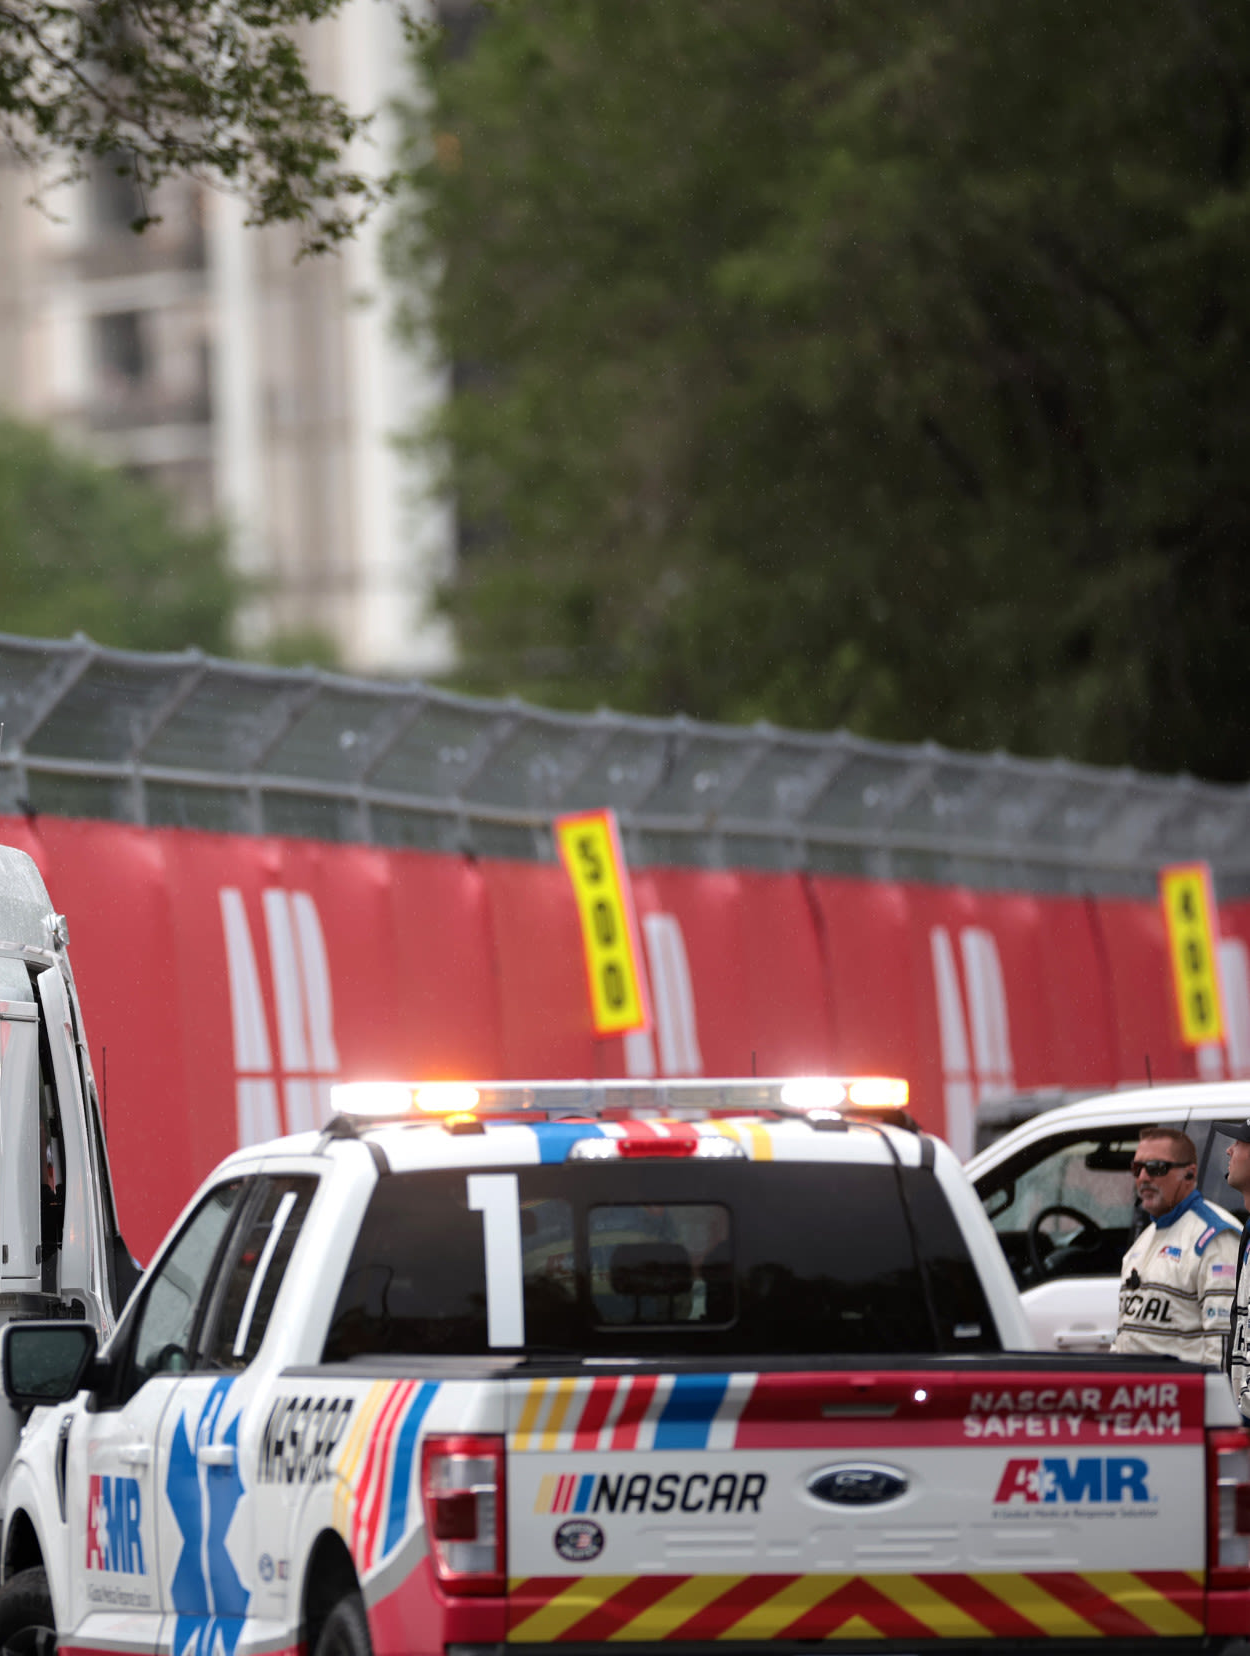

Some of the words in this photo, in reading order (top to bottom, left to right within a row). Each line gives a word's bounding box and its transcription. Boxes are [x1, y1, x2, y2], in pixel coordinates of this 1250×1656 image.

[577, 835, 626, 1012] 500
[1180, 888, 1215, 1029] 400
[467, 1174, 525, 1347] 1
[257, 1397, 354, 1483] NASCAR
[963, 1414, 1083, 1437] SAFETY
[1096, 1411, 1181, 1436] TEAM
[970, 1388, 1101, 1411] NASCAR
[1110, 1383, 1179, 1409] AMR
[593, 1473, 767, 1513] NASCAR
[993, 1457, 1150, 1504] AMR
[86, 1475, 146, 1575] AMR
